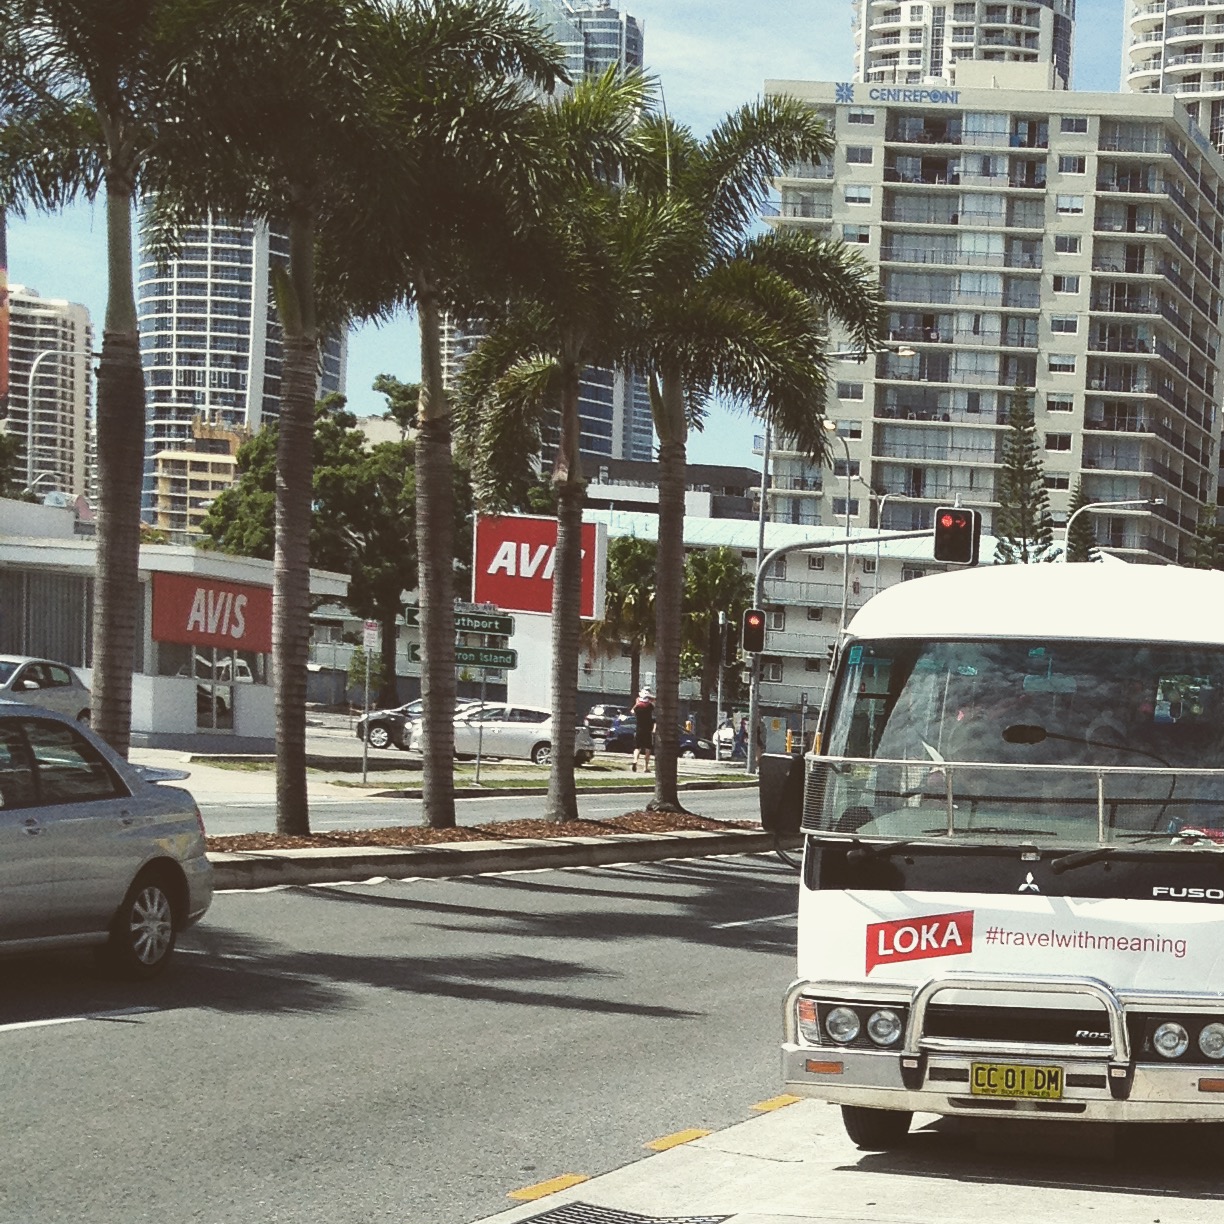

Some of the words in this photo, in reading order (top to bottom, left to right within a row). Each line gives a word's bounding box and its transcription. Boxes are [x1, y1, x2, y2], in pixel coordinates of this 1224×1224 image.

[869, 88, 961, 104] CENTREPOINT
[487, 541, 585, 580] AVI
[186, 588, 249, 639] AVIS
[454, 617, 500, 630] uthport
[1152, 886, 1224, 900] FUSO
[878, 920, 964, 956] LOKA
[985, 926, 1188, 959] #travelwithmeaning
[1075, 1030, 1111, 1040] Ros
